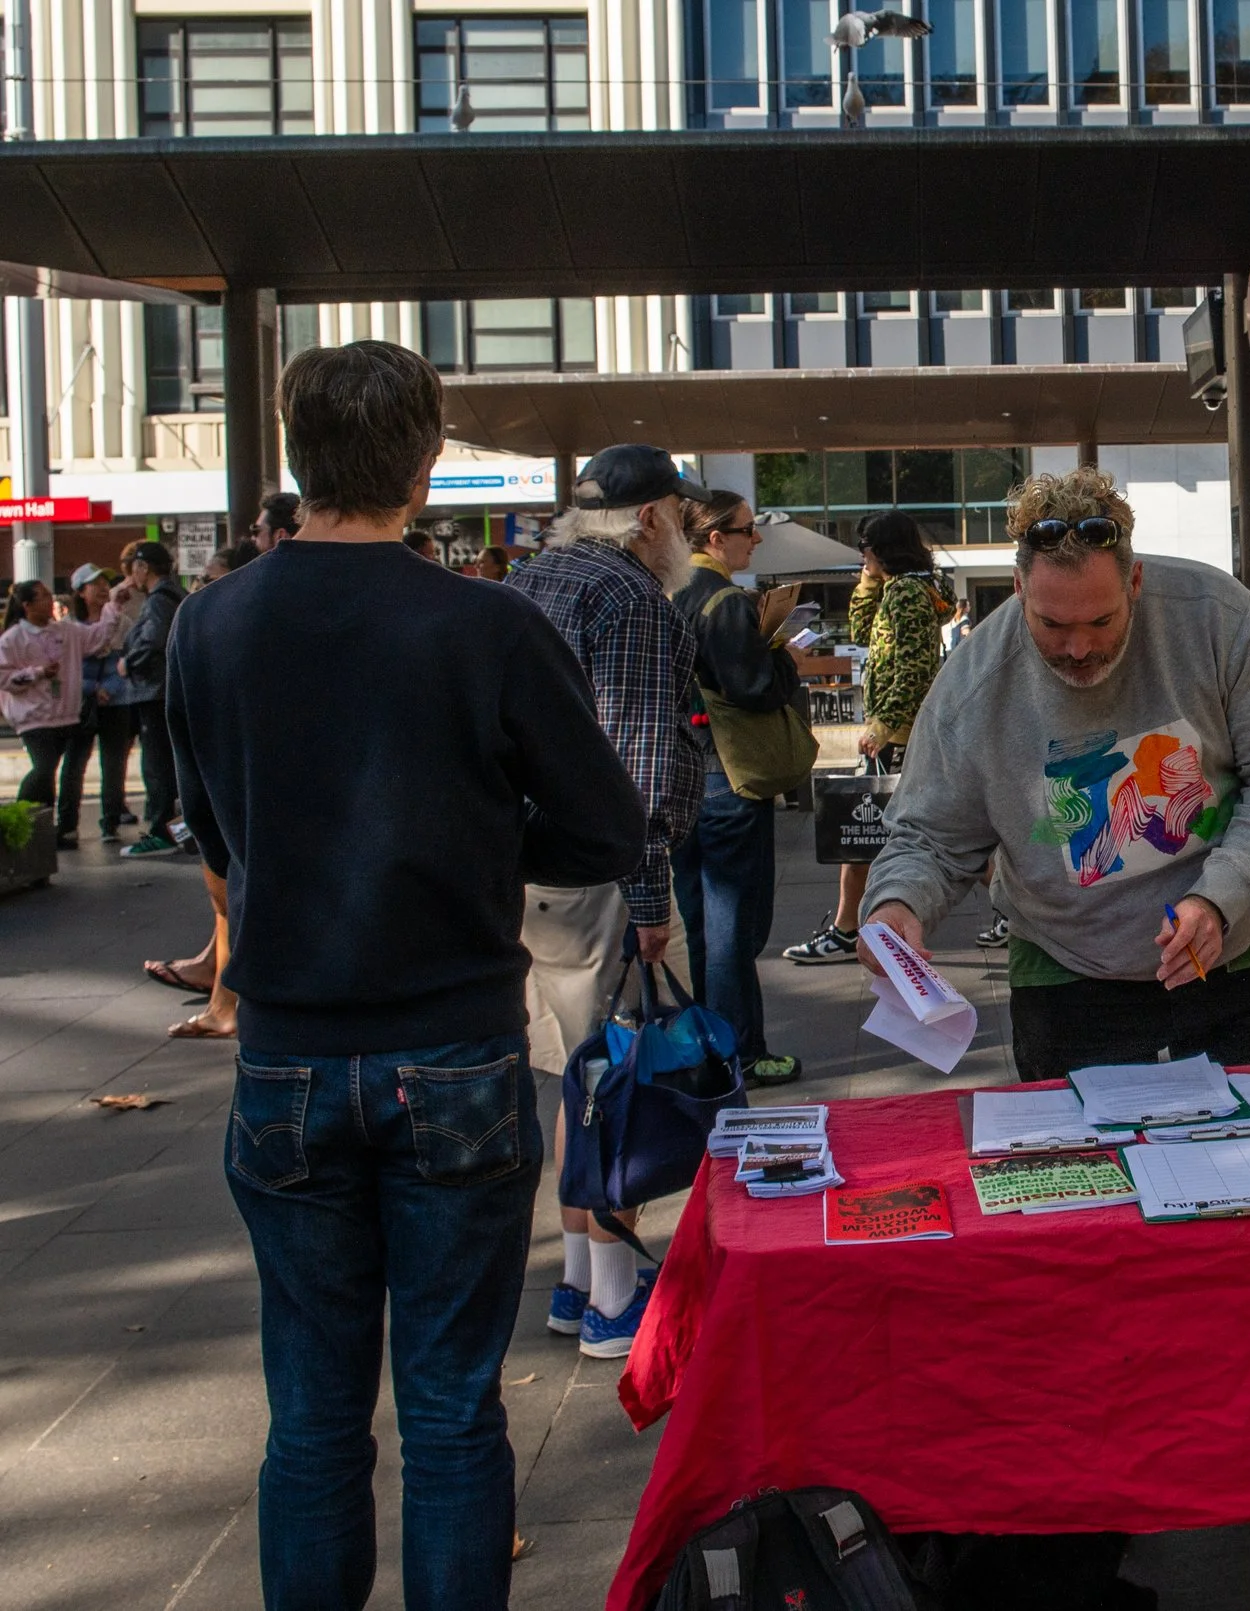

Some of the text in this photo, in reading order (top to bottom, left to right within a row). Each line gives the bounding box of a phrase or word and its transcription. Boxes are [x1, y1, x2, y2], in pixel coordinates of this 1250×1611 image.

[0, 501, 54, 518] wn Hall
[840, 825, 861, 836] THE
[840, 837, 851, 845] OF
[878, 933, 895, 950] ON
[893, 953, 929, 997] MARCH
[985, 1189, 1097, 1208] Palestine
[842, 1215, 941, 1232] MARXISM
[854, 1208, 928, 1224] WORKS
[869, 1225, 917, 1238] HOW
